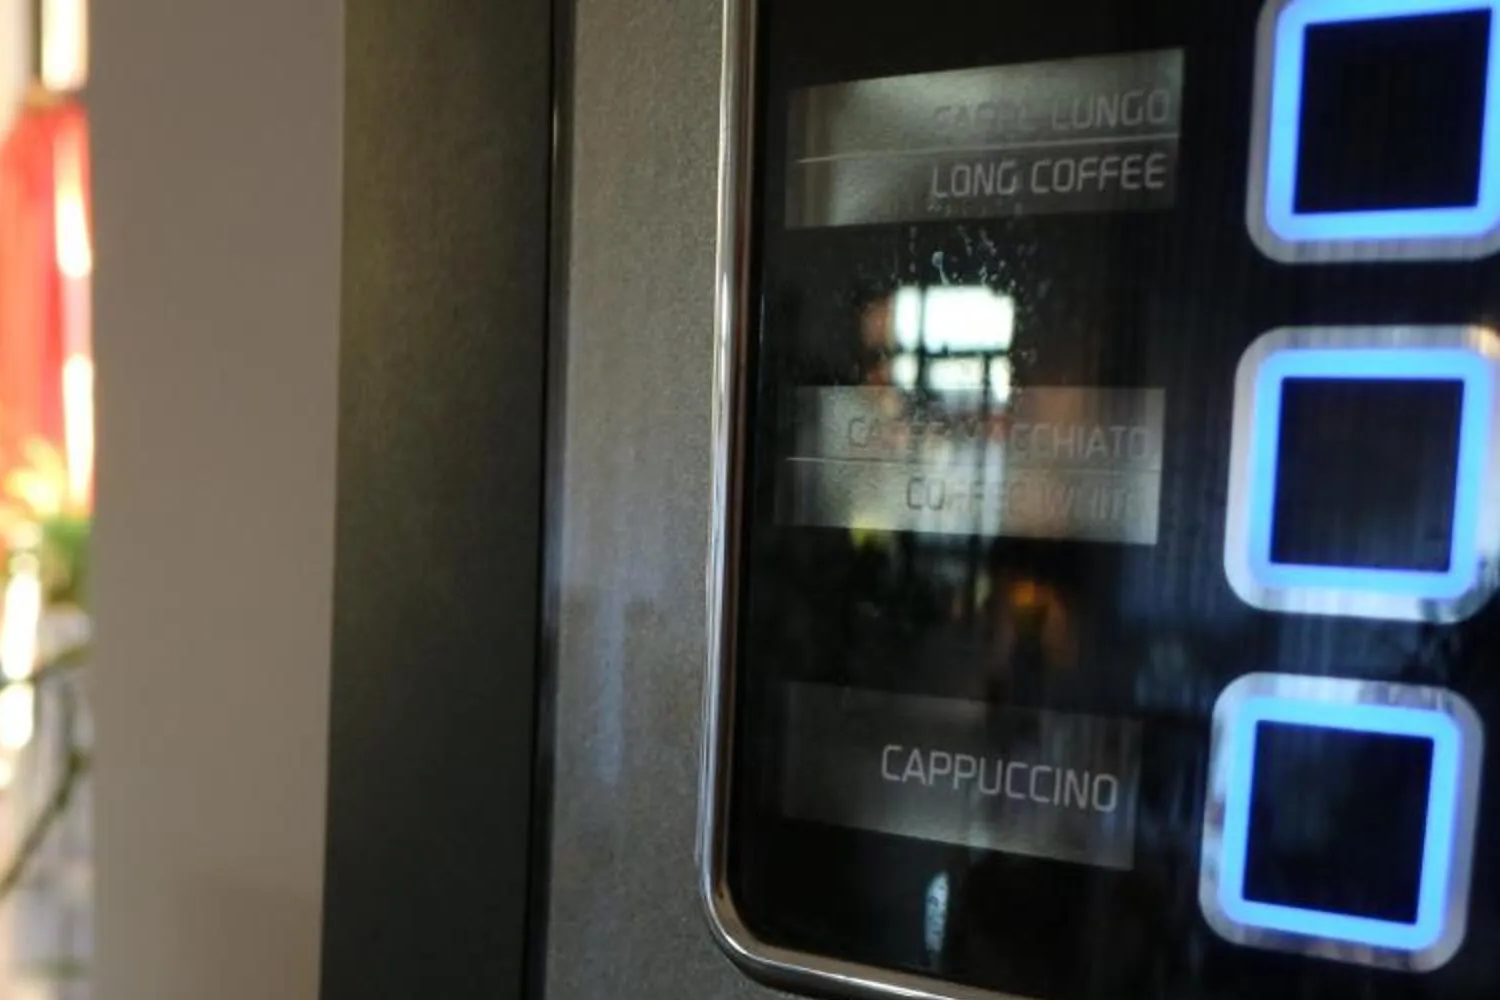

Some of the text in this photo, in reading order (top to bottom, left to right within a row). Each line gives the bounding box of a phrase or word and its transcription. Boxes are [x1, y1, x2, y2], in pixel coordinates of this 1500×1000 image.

[1051, 89, 1170, 131] LUNGO
[932, 152, 1167, 199] LONG COFFEE
[881, 744, 1119, 813] CAPPUCCINO
